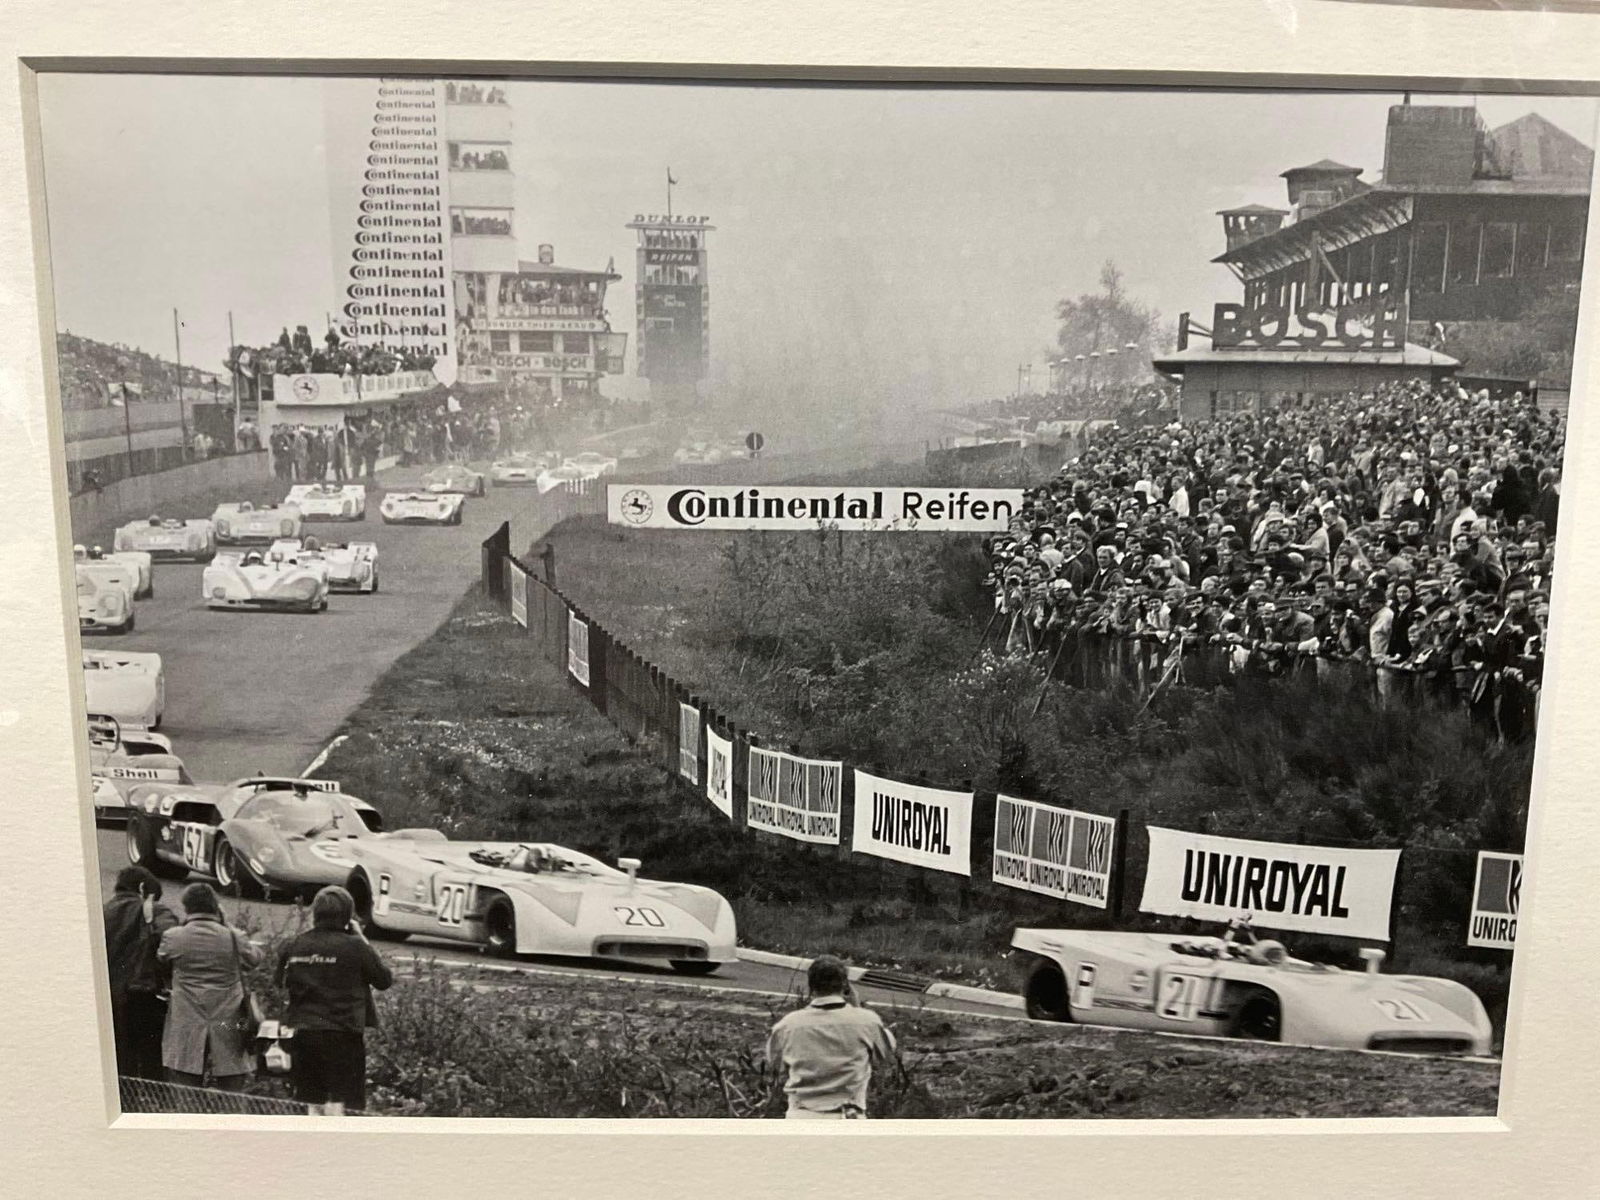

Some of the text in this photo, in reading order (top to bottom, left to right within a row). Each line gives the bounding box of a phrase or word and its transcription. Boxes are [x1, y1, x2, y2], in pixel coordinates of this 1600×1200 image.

[369, 140, 437, 151] Continental
[367, 154, 438, 165] Continental
[364, 169, 439, 180] Continental
[362, 184, 440, 197] Continental
[359, 199, 440, 213] Continental
[357, 215, 441, 227] Continental
[354, 231, 442, 245] Continental
[352, 248, 443, 262] Continental
[350, 265, 444, 280] Continental
[347, 283, 445, 299] Continental
[344, 302, 446, 318] Continental
[1211, 302, 1404, 350] BOSCH
[667, 488, 883, 525] Continental
[903, 491, 1012, 520] Reifen
[113, 768, 158, 778] Shell
[871, 791, 952, 855] UNIROYAL
[995, 855, 1104, 900] UNIROYAL UNIROYAL UNIROYAL
[1181, 849, 1349, 918] UNIROYAL
[438, 886, 464, 924] 20
[614, 906, 665, 927] 20
[1164, 976, 1196, 1018] 21
[1378, 1000, 1425, 1020] 21
